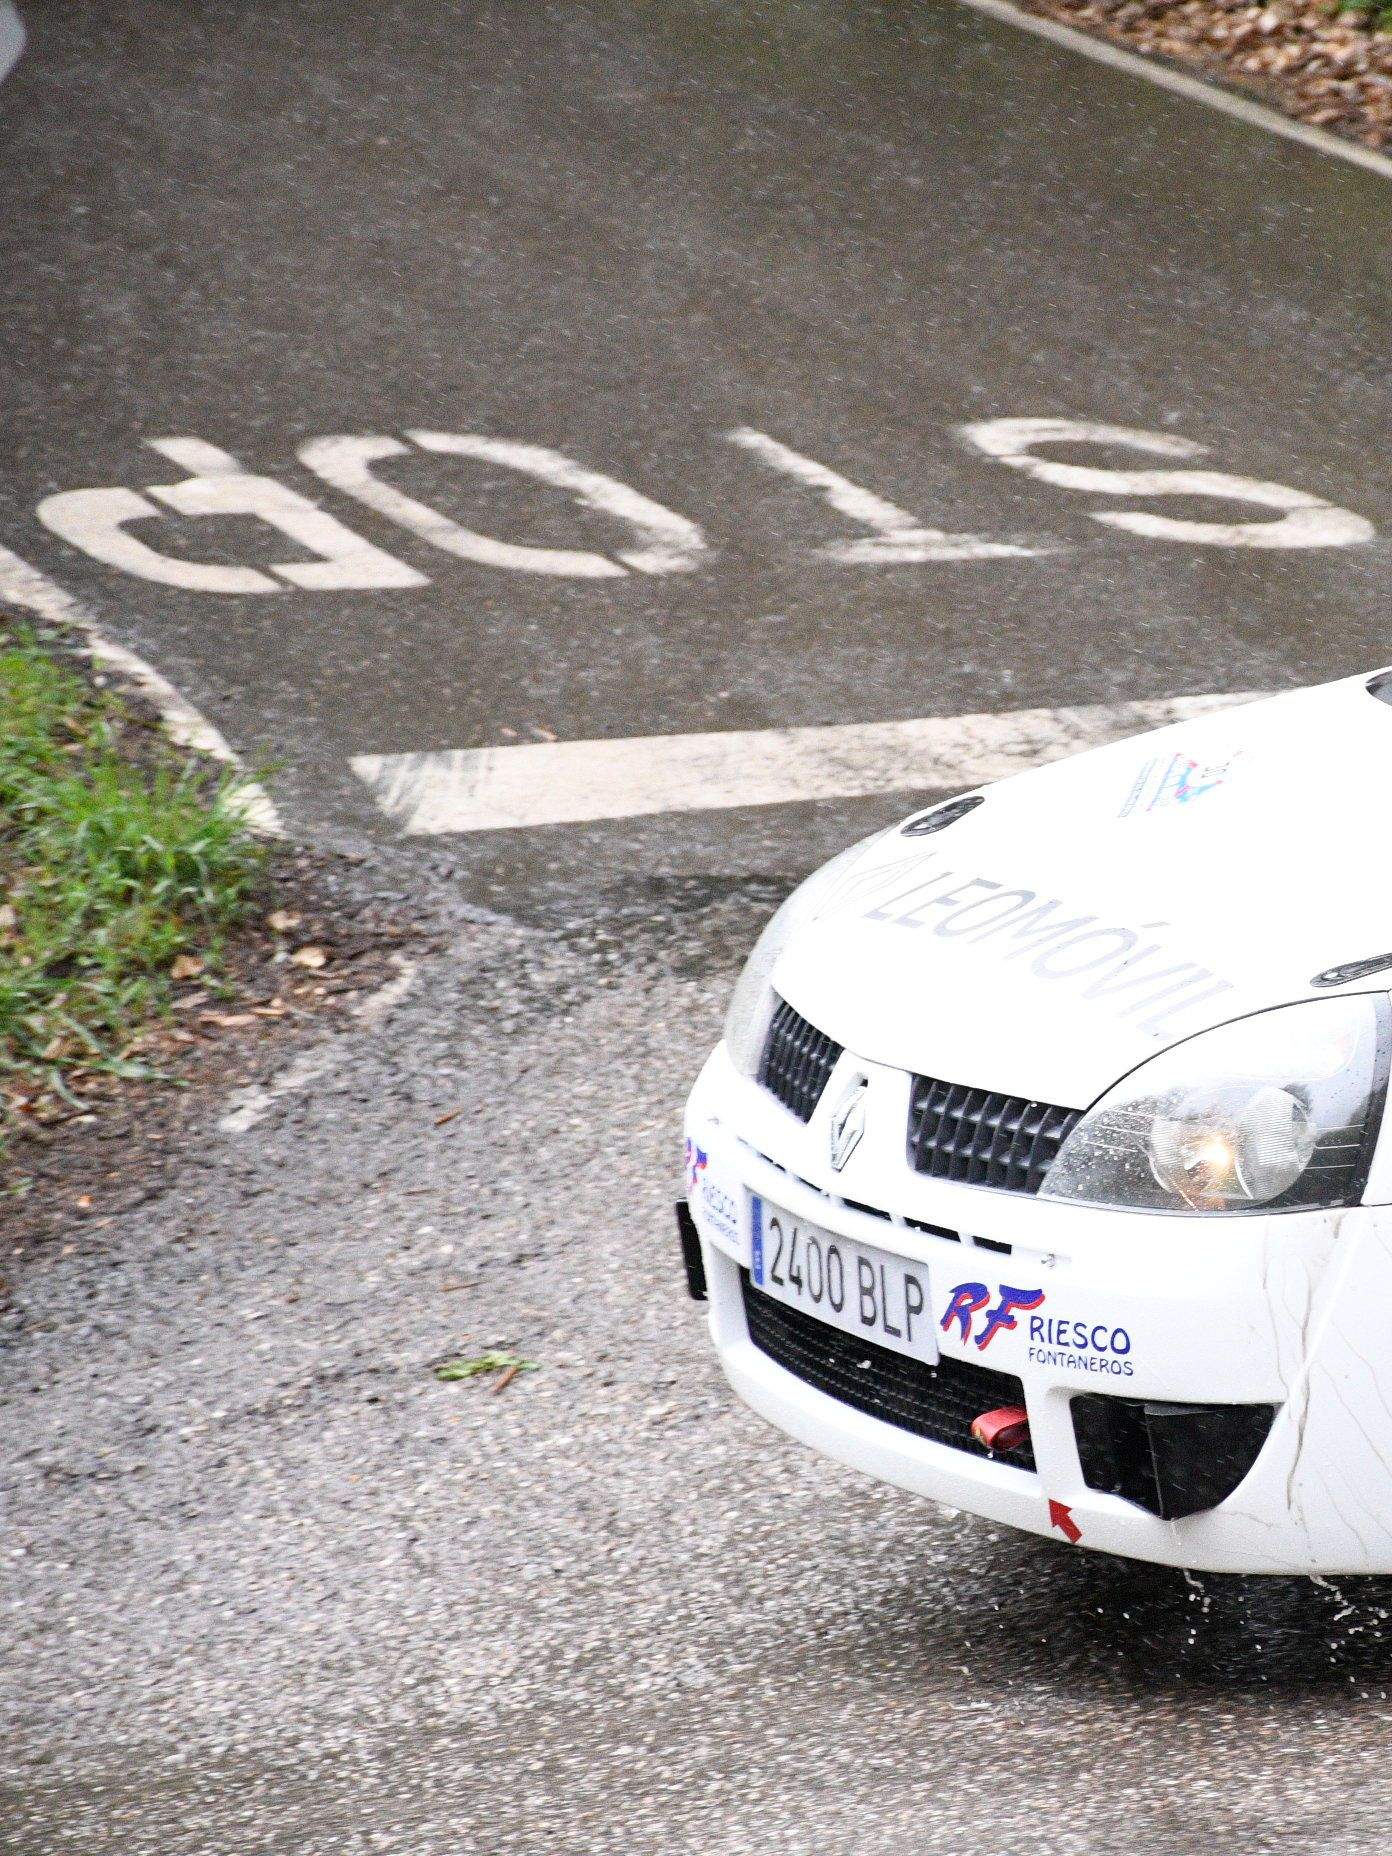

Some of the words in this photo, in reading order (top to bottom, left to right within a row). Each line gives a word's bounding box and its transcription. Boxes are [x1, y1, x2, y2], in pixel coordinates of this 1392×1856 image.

[34, 414, 1377, 594] STOP
[863, 870, 1236, 1042] LEOMÓVIL
[769, 1216, 845, 1313] 2400
[857, 1255, 924, 1342] BLP
[940, 1282, 1046, 1351] RF
[1028, 1347, 1134, 1376] FONTANEROS
[1029, 1315, 1132, 1355] RIESCO
